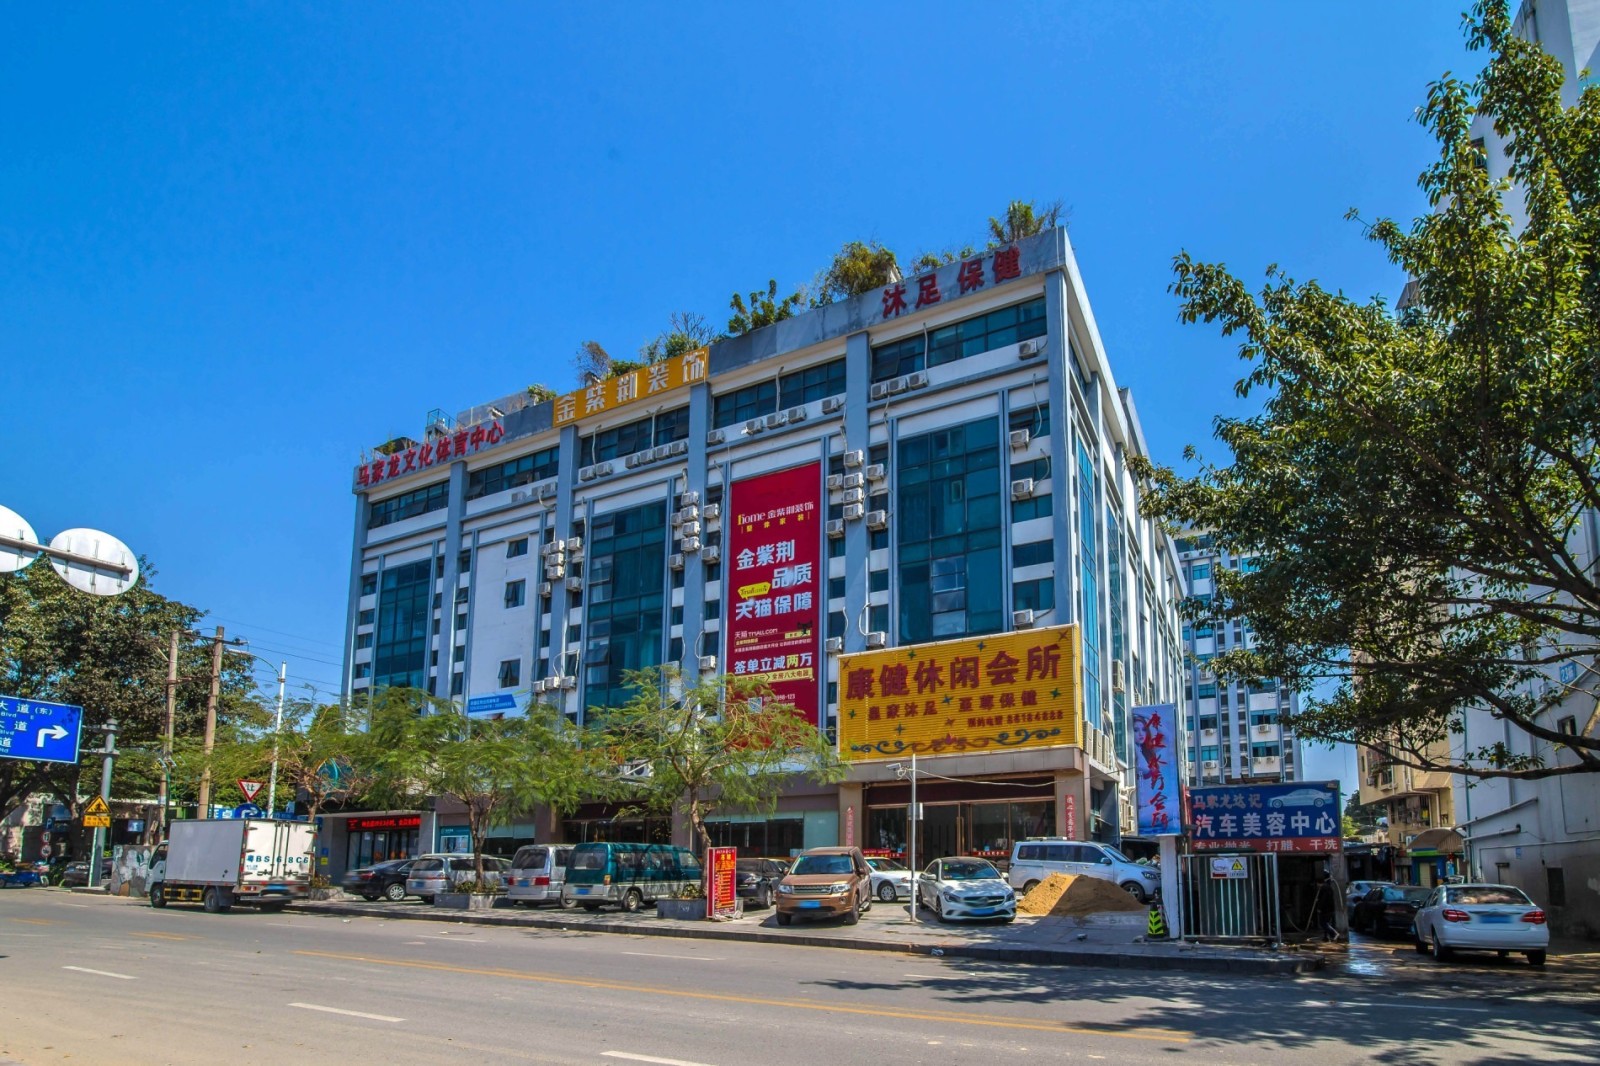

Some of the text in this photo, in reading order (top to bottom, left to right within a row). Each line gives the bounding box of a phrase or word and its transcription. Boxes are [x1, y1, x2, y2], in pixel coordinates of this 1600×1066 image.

[556, 351, 706, 424] 金紫荆装饰
[356, 420, 505, 487] 马家龙文化体育中心
[736, 539, 796, 571] 金紫荆
[771, 562, 812, 590] 品质
[735, 591, 813, 621] 天猫保障
[734, 652, 813, 675] 签单立减两万
[845, 643, 1062, 700] 康健休闲会所
[1195, 810, 1337, 838] 汽车美容中心
[1310, 839, 1338, 850] 干洗
